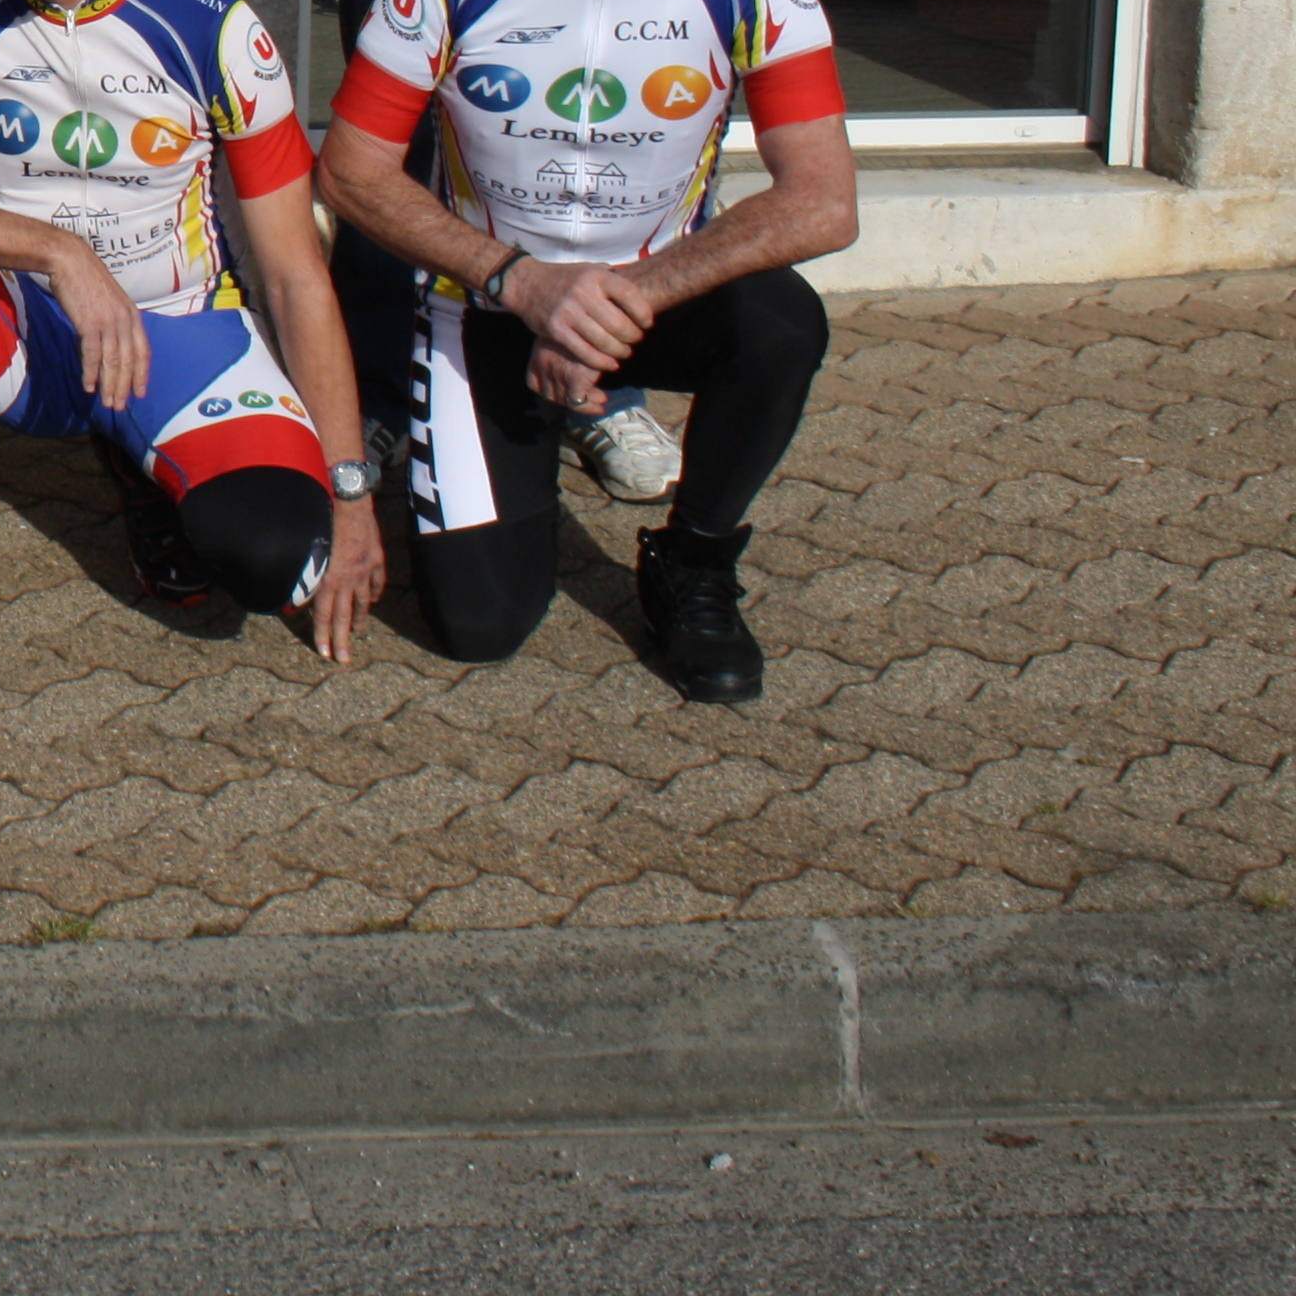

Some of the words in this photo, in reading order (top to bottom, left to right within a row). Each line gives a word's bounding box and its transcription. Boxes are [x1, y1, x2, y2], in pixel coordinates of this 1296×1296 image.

[614, 20, 690, 42] C.C.M
[253, 35, 275, 61] U
[101, 74, 169, 94] C.C.M
[500, 119, 664, 146] Lembeye
[93, 218, 174, 254] EILLES
